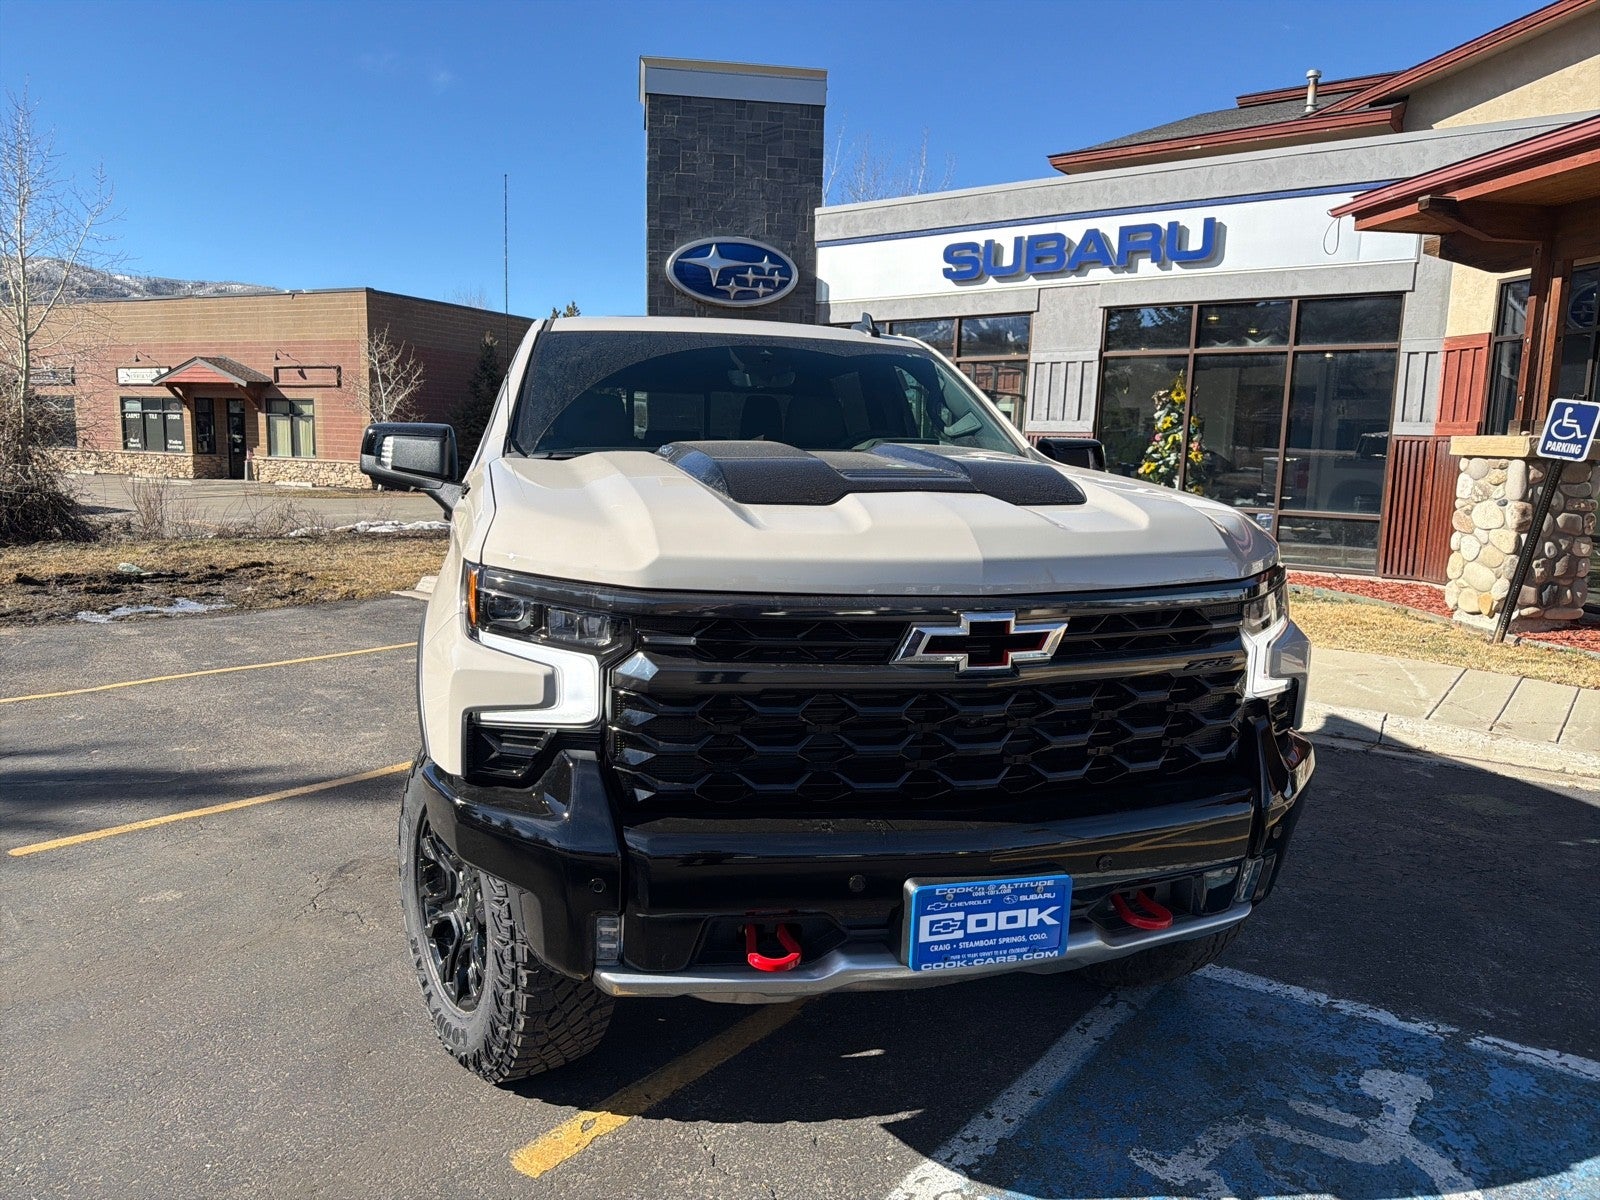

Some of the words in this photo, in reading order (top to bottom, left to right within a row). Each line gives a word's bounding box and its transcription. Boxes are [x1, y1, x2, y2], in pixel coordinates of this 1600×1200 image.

[942, 217, 1217, 280] SUBARU
[1545, 440, 1582, 455] PARKING
[998, 879, 1055, 890] ALTITUDE
[949, 898, 993, 908] CHEVROLET
[1019, 892, 1056, 902] SUBARU
[918, 906, 1061, 943] COOK
[930, 944, 951, 953] CRAIG
[958, 939, 997, 949] STEAMBOAT
[998, 935, 1027, 945] SPRINGS,
[1029, 932, 1048, 941] COLO.
[921, 950, 1059, 971] COOK-CARS.COM
